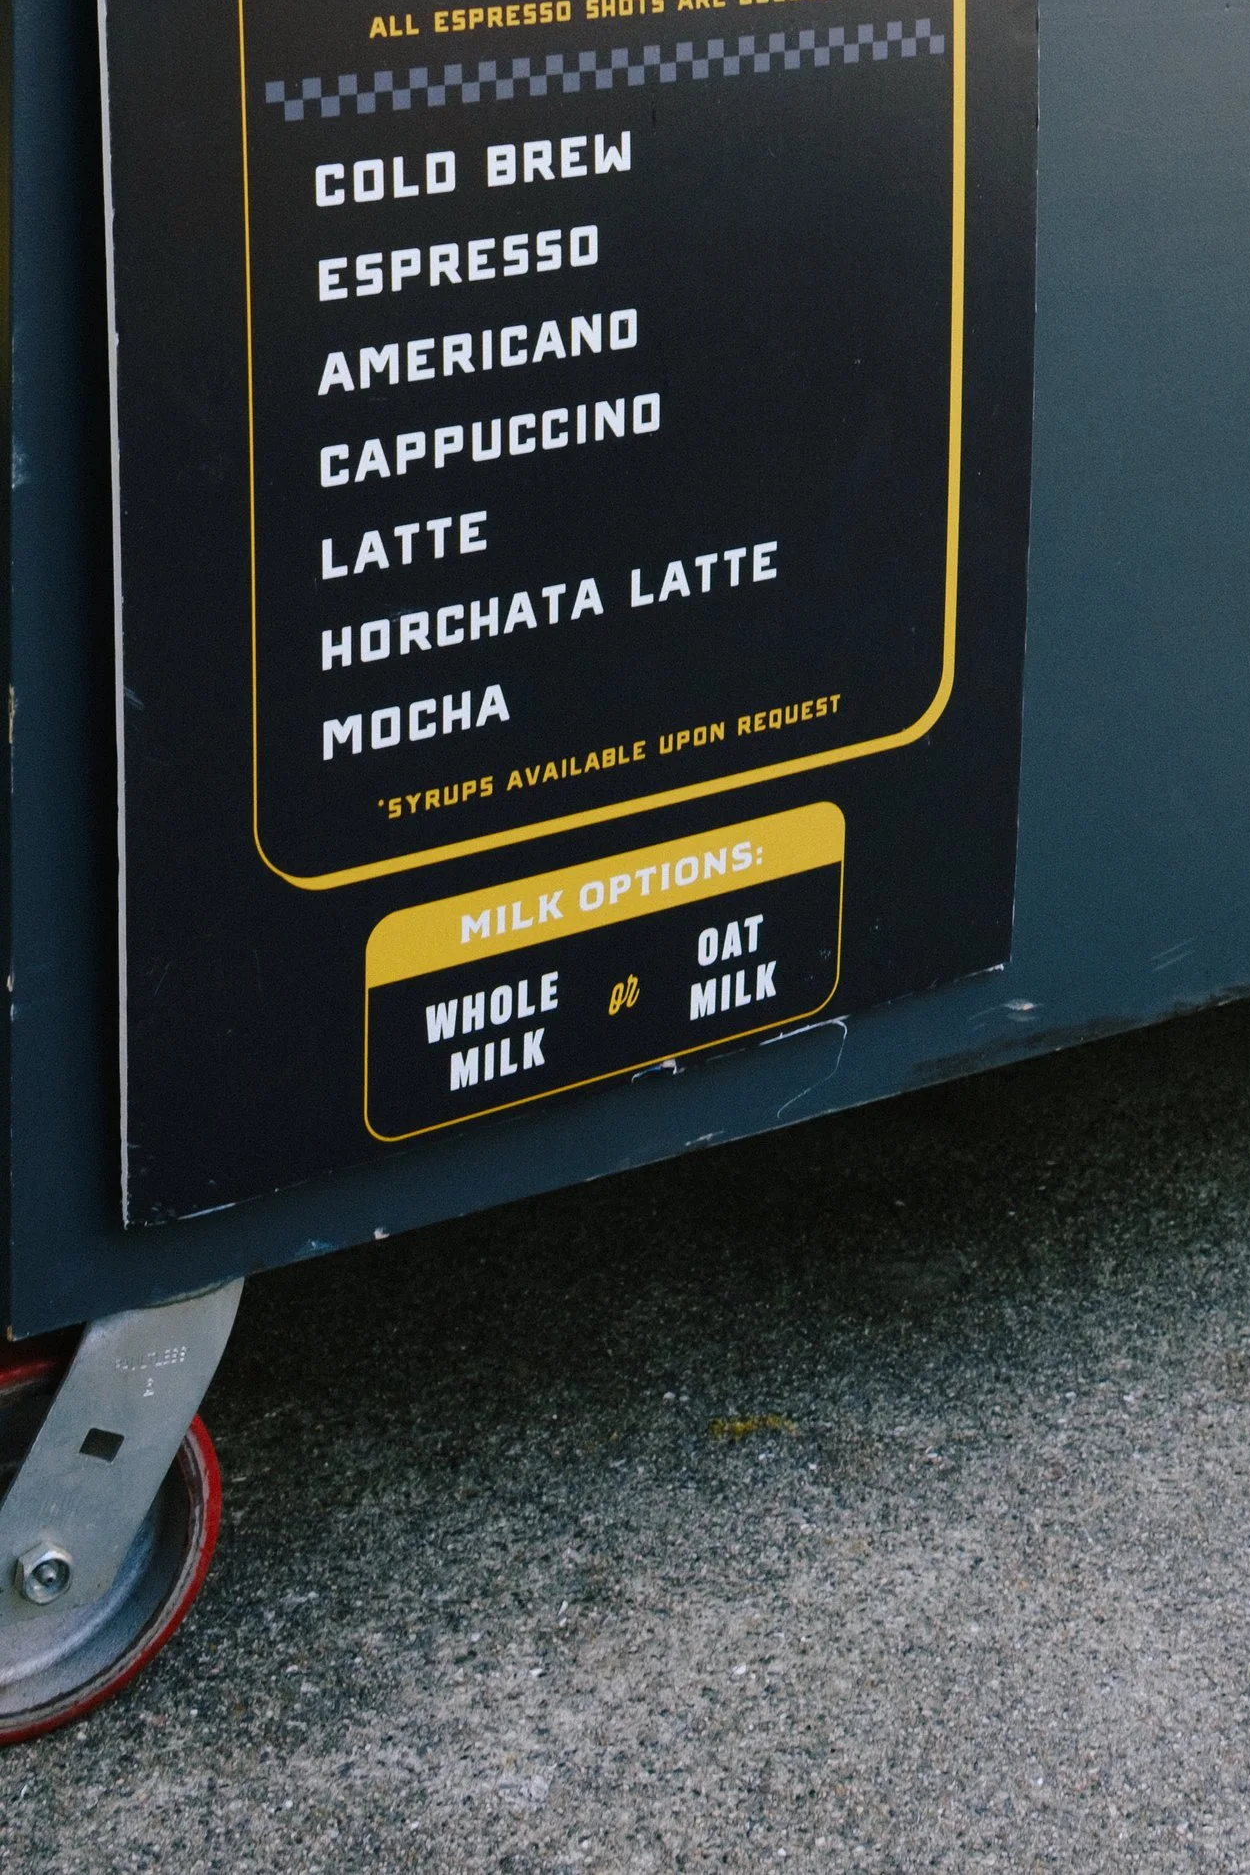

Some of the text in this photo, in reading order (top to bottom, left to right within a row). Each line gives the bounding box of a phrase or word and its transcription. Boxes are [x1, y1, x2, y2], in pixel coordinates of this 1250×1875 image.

[369, 14, 420, 39] ALL
[434, 0, 572, 32] ESPRESSO
[316, 131, 632, 206] COLD BREW
[319, 225, 599, 301] ESPRESSO
[318, 309, 638, 395] AMERICANO
[320, 393, 661, 488] CAPPUCCINO
[322, 511, 487, 580] LATTE
[322, 541, 778, 671] HORCHATA LATTE
[324, 685, 510, 761] MOCHA
[507, 741, 646, 791] AVAILABLE
[660, 722, 725, 755] UPON
[738, 694, 841, 737] REQUEST
[461, 842, 765, 944] MILK OPTIONS:
[698, 915, 764, 966] OAT
[426, 972, 559, 1044] WHOLE
[609, 974, 640, 1016] or
[690, 961, 777, 1021] MILK
[450, 1028, 545, 1091] MILK
